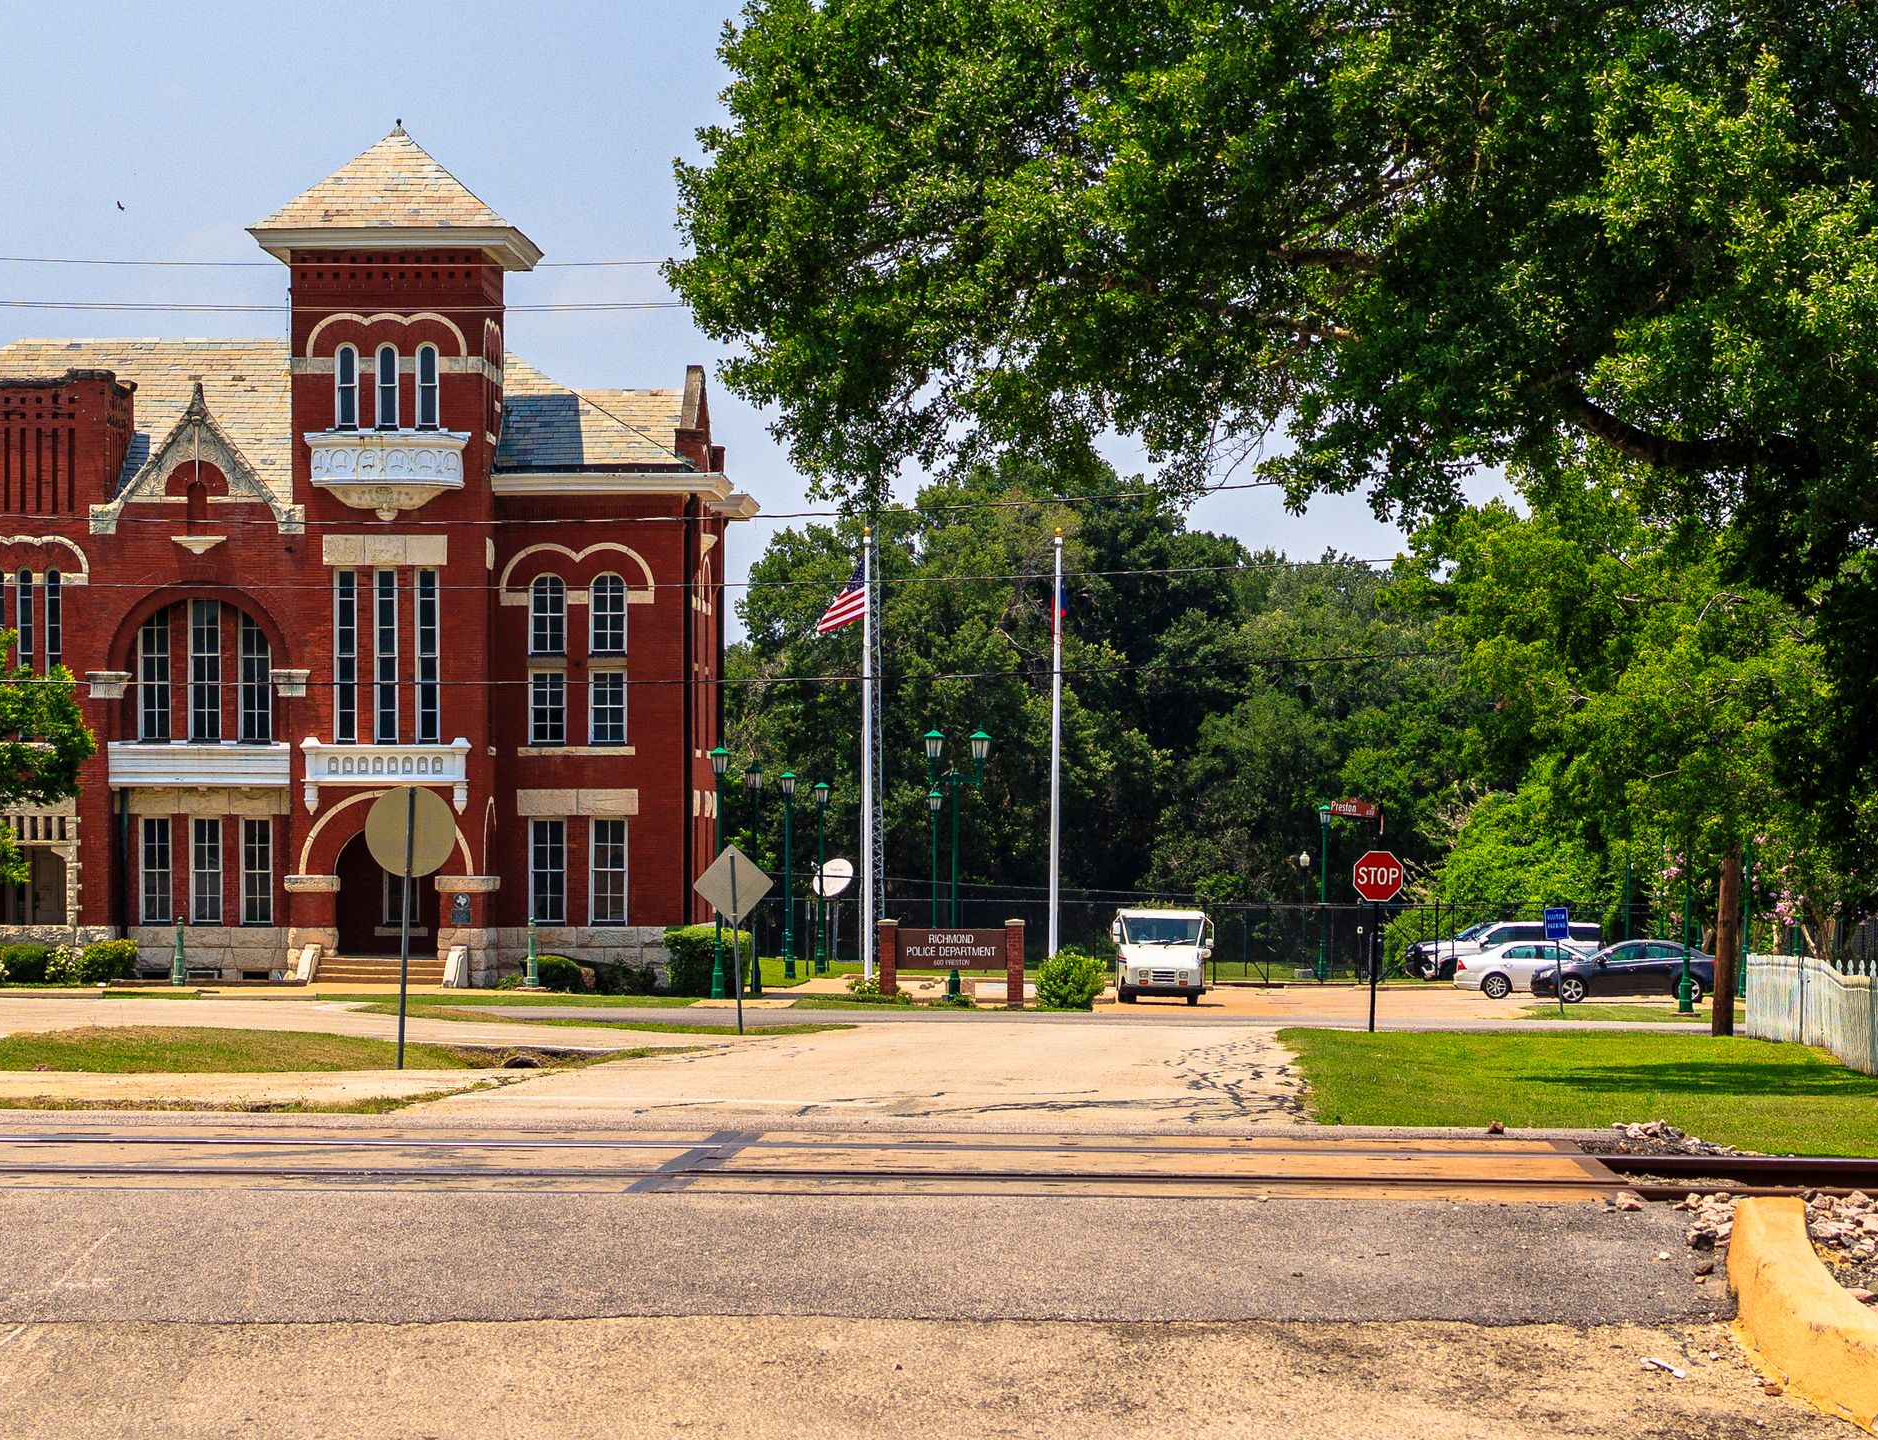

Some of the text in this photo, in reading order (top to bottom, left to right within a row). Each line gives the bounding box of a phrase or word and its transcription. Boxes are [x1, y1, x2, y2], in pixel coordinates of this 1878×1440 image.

[1330, 800, 1357, 813] Preston
[1357, 867, 1399, 886] STOP
[928, 933, 974, 944] RICHMOND
[906, 946, 996, 957] POLICE DEPARTMENT
